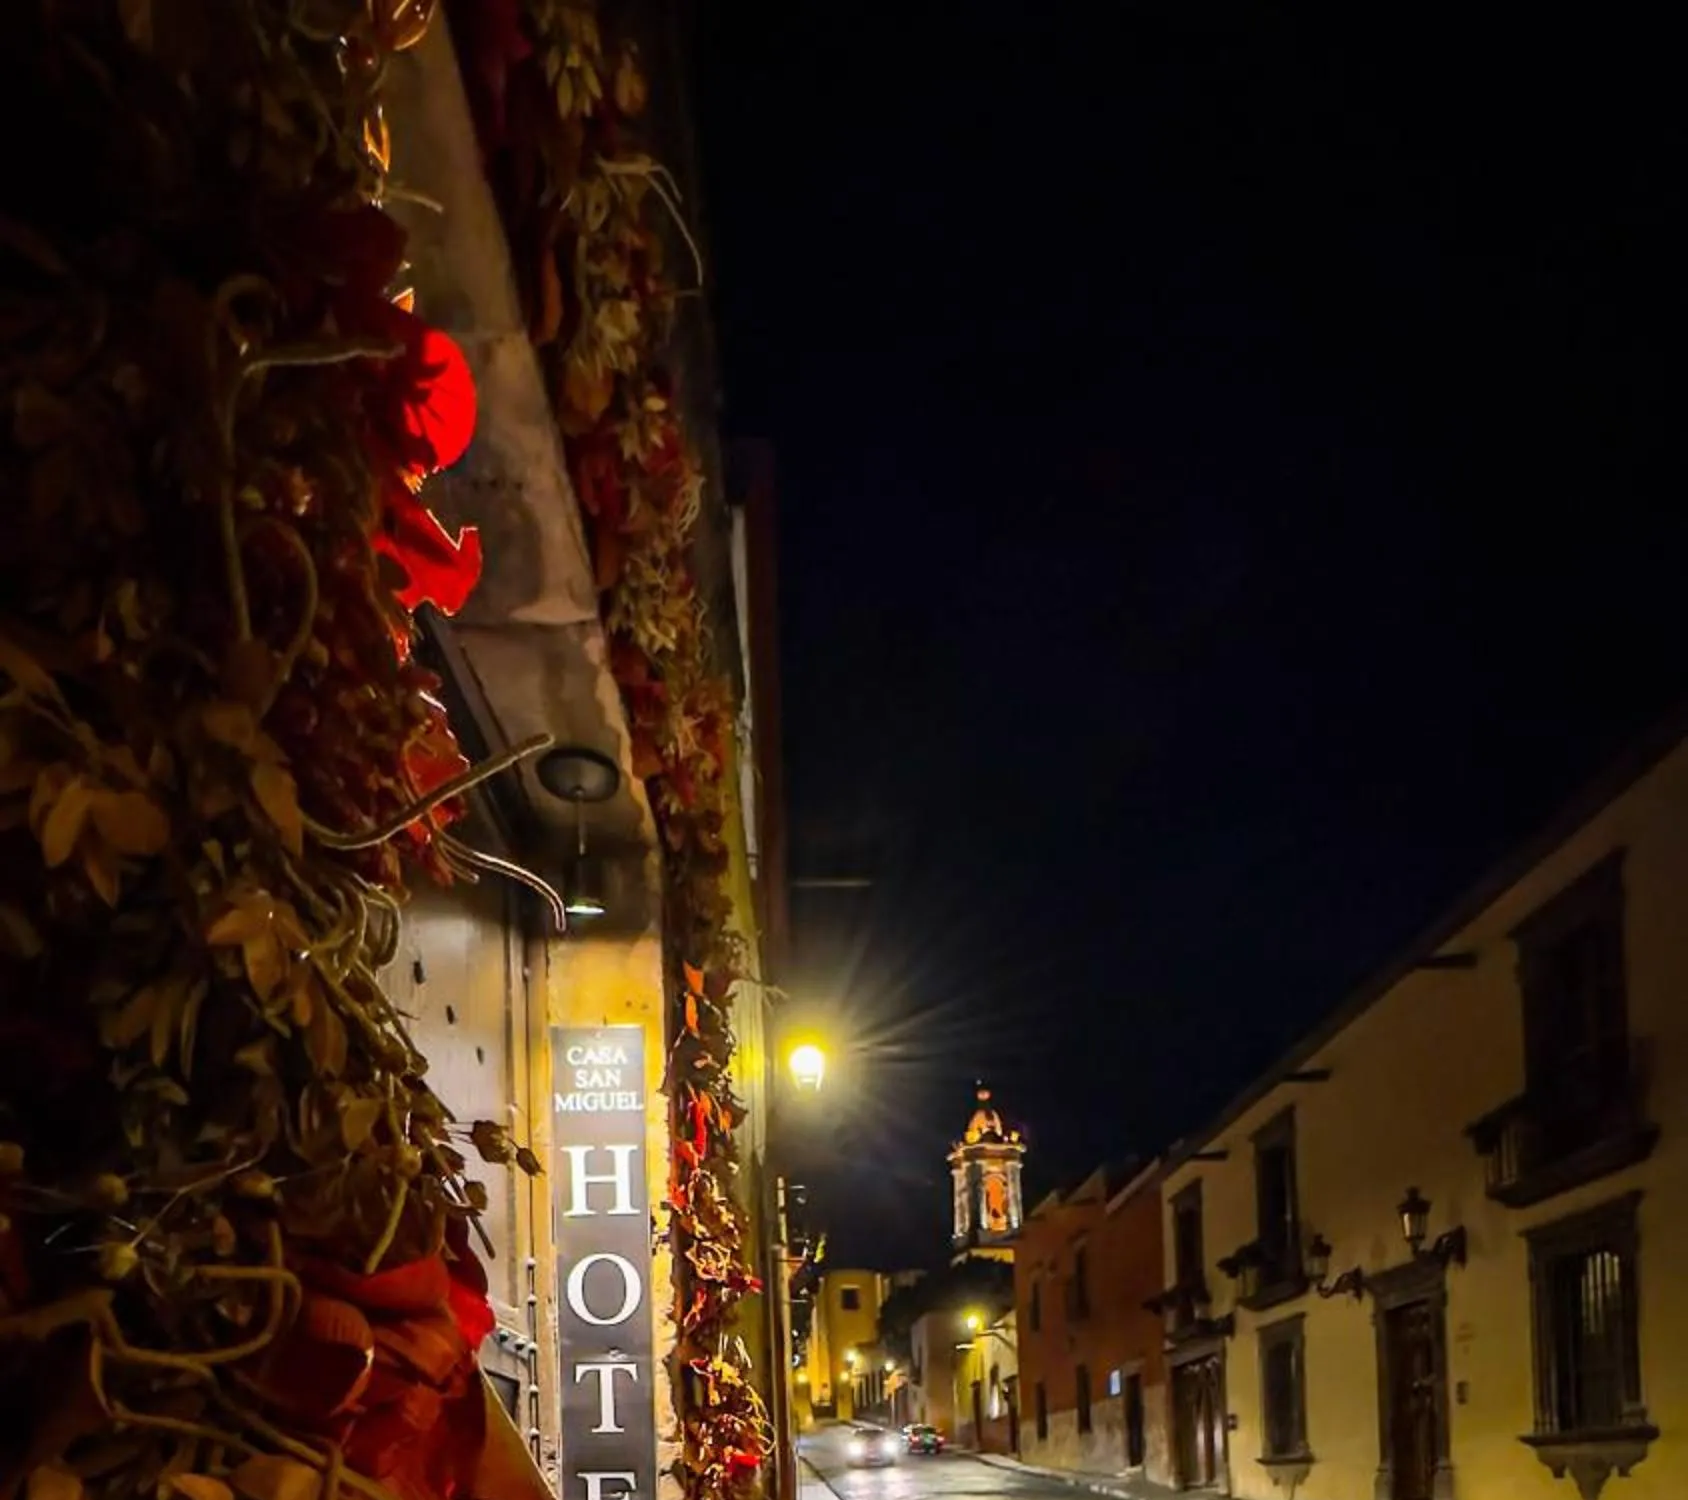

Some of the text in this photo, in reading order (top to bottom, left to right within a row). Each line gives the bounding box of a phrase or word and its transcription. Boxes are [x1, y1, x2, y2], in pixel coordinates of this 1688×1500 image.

[566, 1045, 628, 1067] CASA
[575, 1068, 622, 1090] SAN
[554, 1091, 645, 1113] MIGUEL
